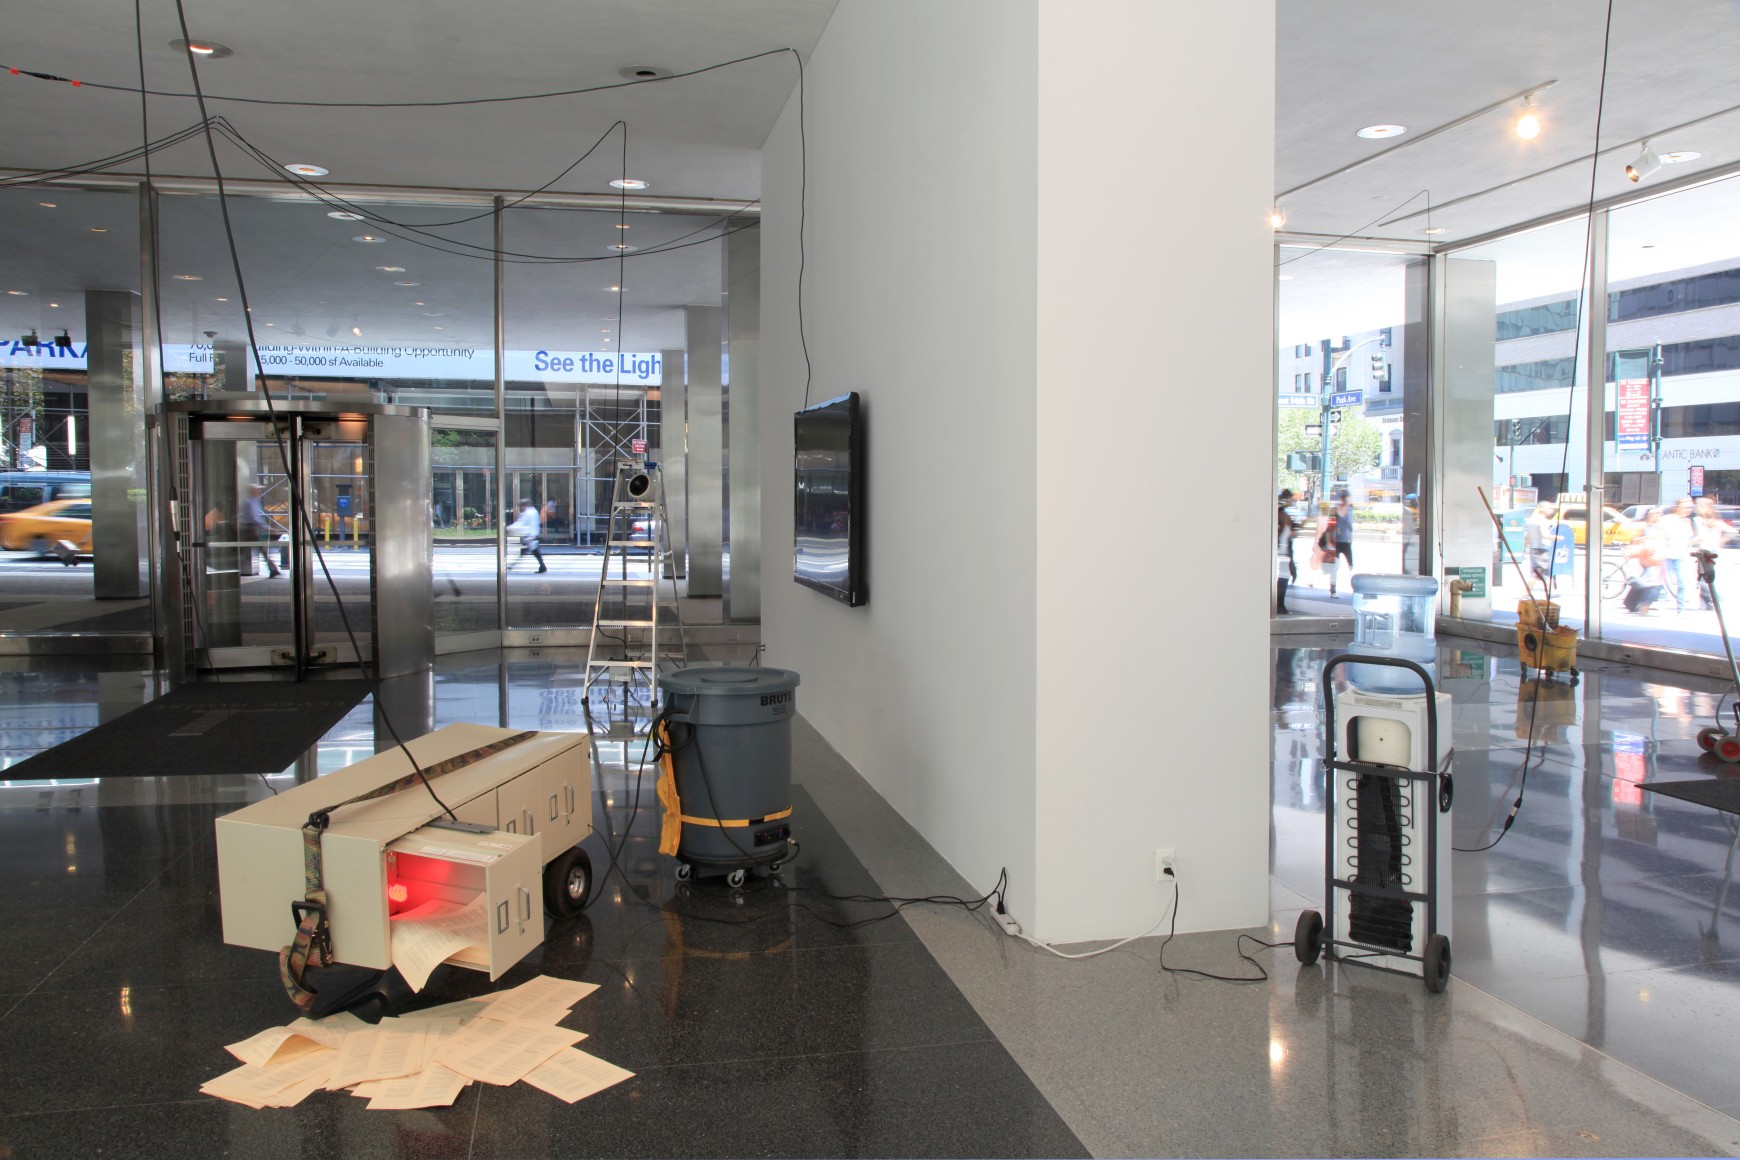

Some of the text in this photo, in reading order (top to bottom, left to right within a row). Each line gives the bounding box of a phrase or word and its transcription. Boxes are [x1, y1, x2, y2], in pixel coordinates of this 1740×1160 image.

[189, 353, 206, 363] Full
[294, 356, 327, 367] 50,000
[328, 356, 338, 367] sf
[338, 357, 384, 368] Available
[534, 350, 661, 379] See the Ligh
[1690, 448, 1713, 459] BANK
[761, 691, 792, 706] BRUTE
